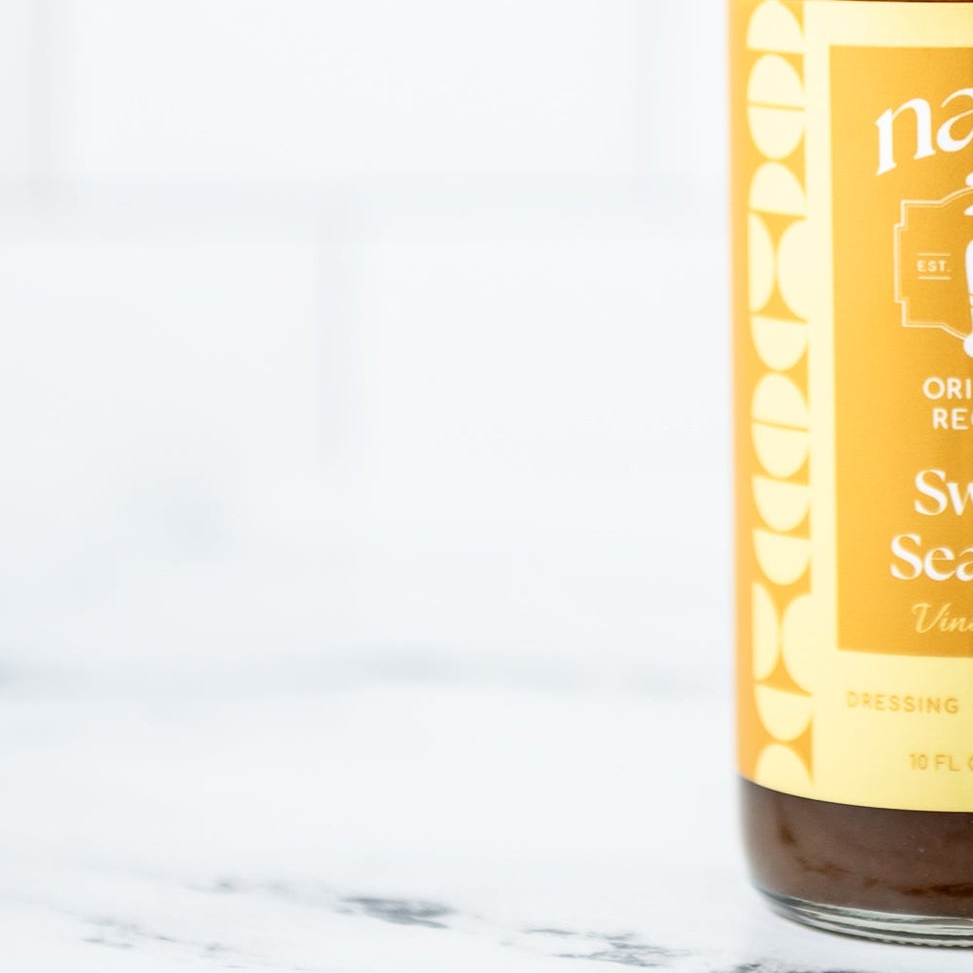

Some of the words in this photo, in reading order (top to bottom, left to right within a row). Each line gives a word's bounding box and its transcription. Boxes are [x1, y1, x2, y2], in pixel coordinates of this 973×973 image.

[917, 259, 952, 274] EST.
[846, 691, 960, 715] DRESSING
[909, 753, 928, 772] 10
[934, 754, 960, 773] FL
